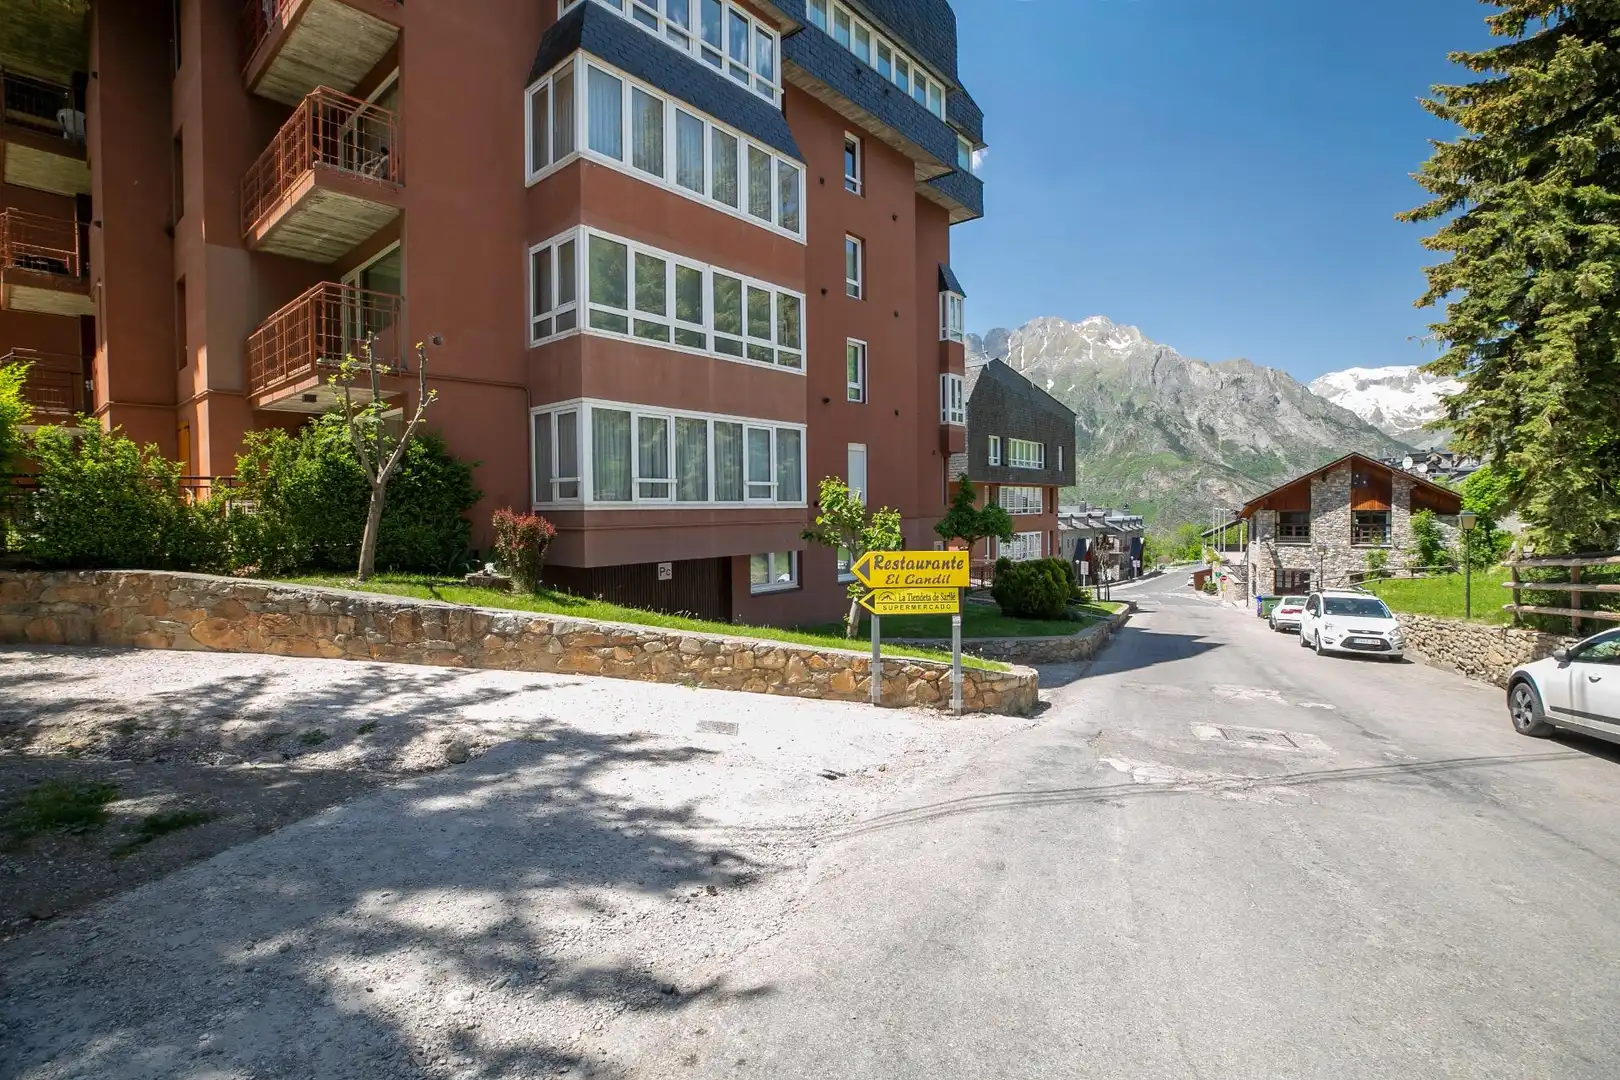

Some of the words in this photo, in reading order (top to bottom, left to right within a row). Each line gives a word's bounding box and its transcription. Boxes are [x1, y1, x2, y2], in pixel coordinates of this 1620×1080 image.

[873, 554, 964, 570] Restaurante
[885, 573, 900, 585] El
[904, 573, 951, 585] Candil
[932, 592, 939, 601] de
[882, 603, 952, 611] SUPERMERCADO
